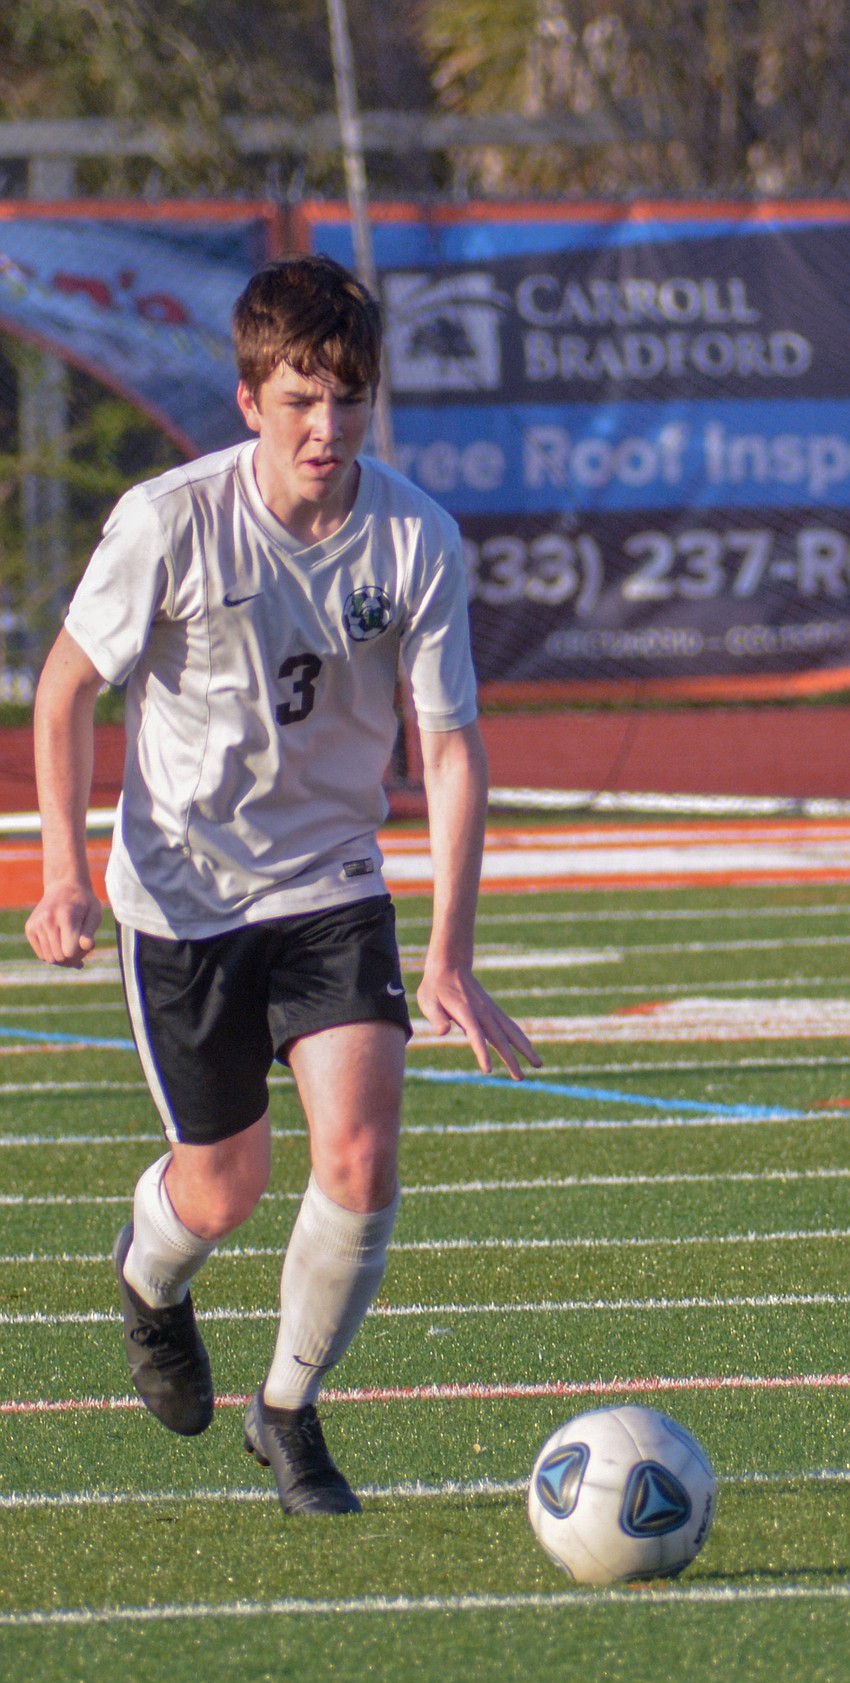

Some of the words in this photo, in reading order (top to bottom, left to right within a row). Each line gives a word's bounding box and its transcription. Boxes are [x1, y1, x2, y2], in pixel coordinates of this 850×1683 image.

[523, 329, 813, 381] BRADFORD
[394, 438, 506, 492] ree
[523, 422, 688, 491] Roof
[703, 420, 850, 498] Insp
[621, 528, 850, 602] 237-R
[275, 652, 323, 726] 3
